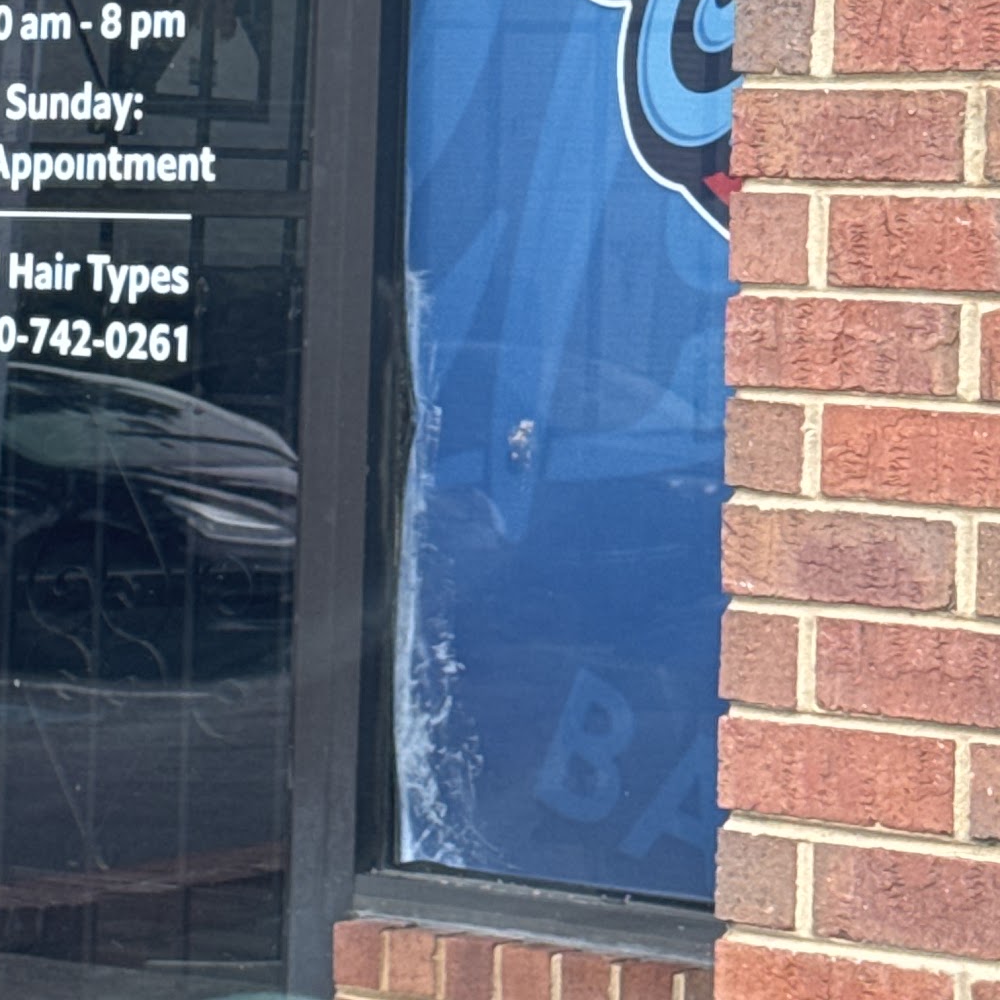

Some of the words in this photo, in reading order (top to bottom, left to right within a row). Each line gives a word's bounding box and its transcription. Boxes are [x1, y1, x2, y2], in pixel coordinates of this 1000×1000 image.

[19, 11, 72, 41] am
[100, 2, 122, 40] 8
[130, 9, 187, 50] pm
[5, 80, 144, 132] Sunday:
[8, 251, 81, 291] Hair
[86, 253, 189, 304] Types
